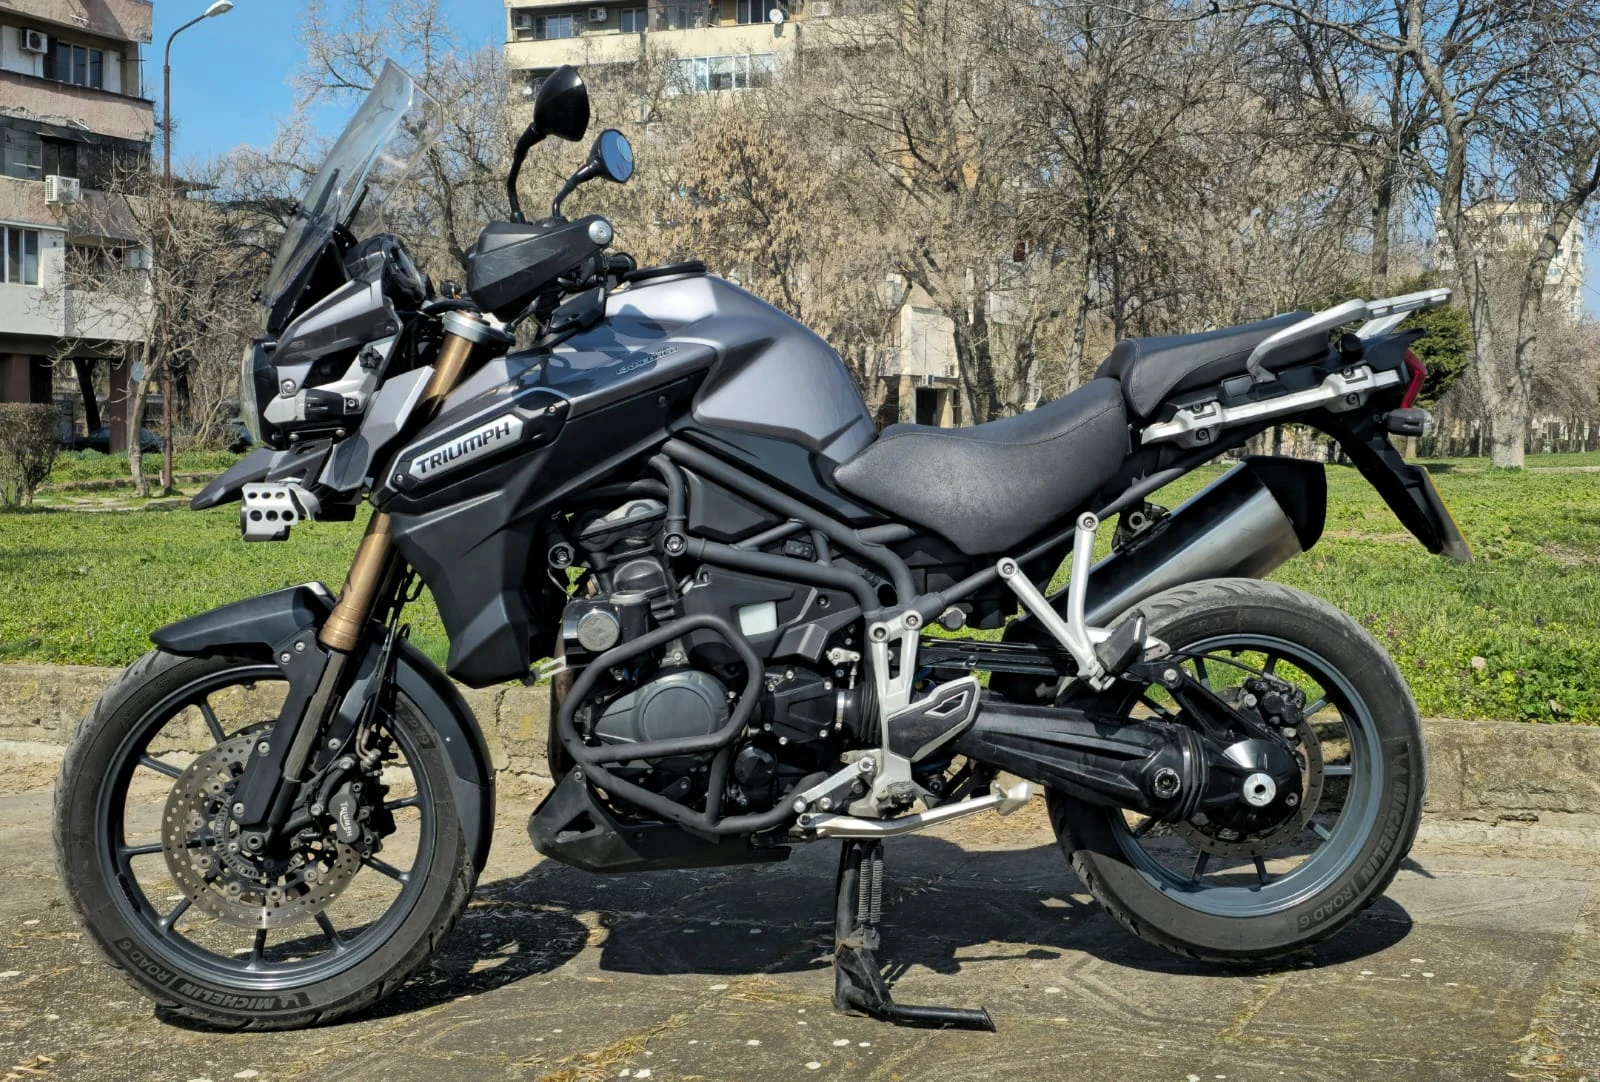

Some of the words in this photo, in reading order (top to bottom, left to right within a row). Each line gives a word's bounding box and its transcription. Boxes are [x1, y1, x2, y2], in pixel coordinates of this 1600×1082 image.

[416, 422, 510, 474] TRIUMPH
[340, 800, 353, 837] TRIUMPH
[1358, 781, 1409, 881] MICHELIN
[1313, 882, 1355, 921] ROAD
[1300, 916, 1311, 928] 6
[118, 940, 132, 951] 6
[130, 952, 168, 981] ROAD
[177, 984, 277, 1010] MICHELIN
